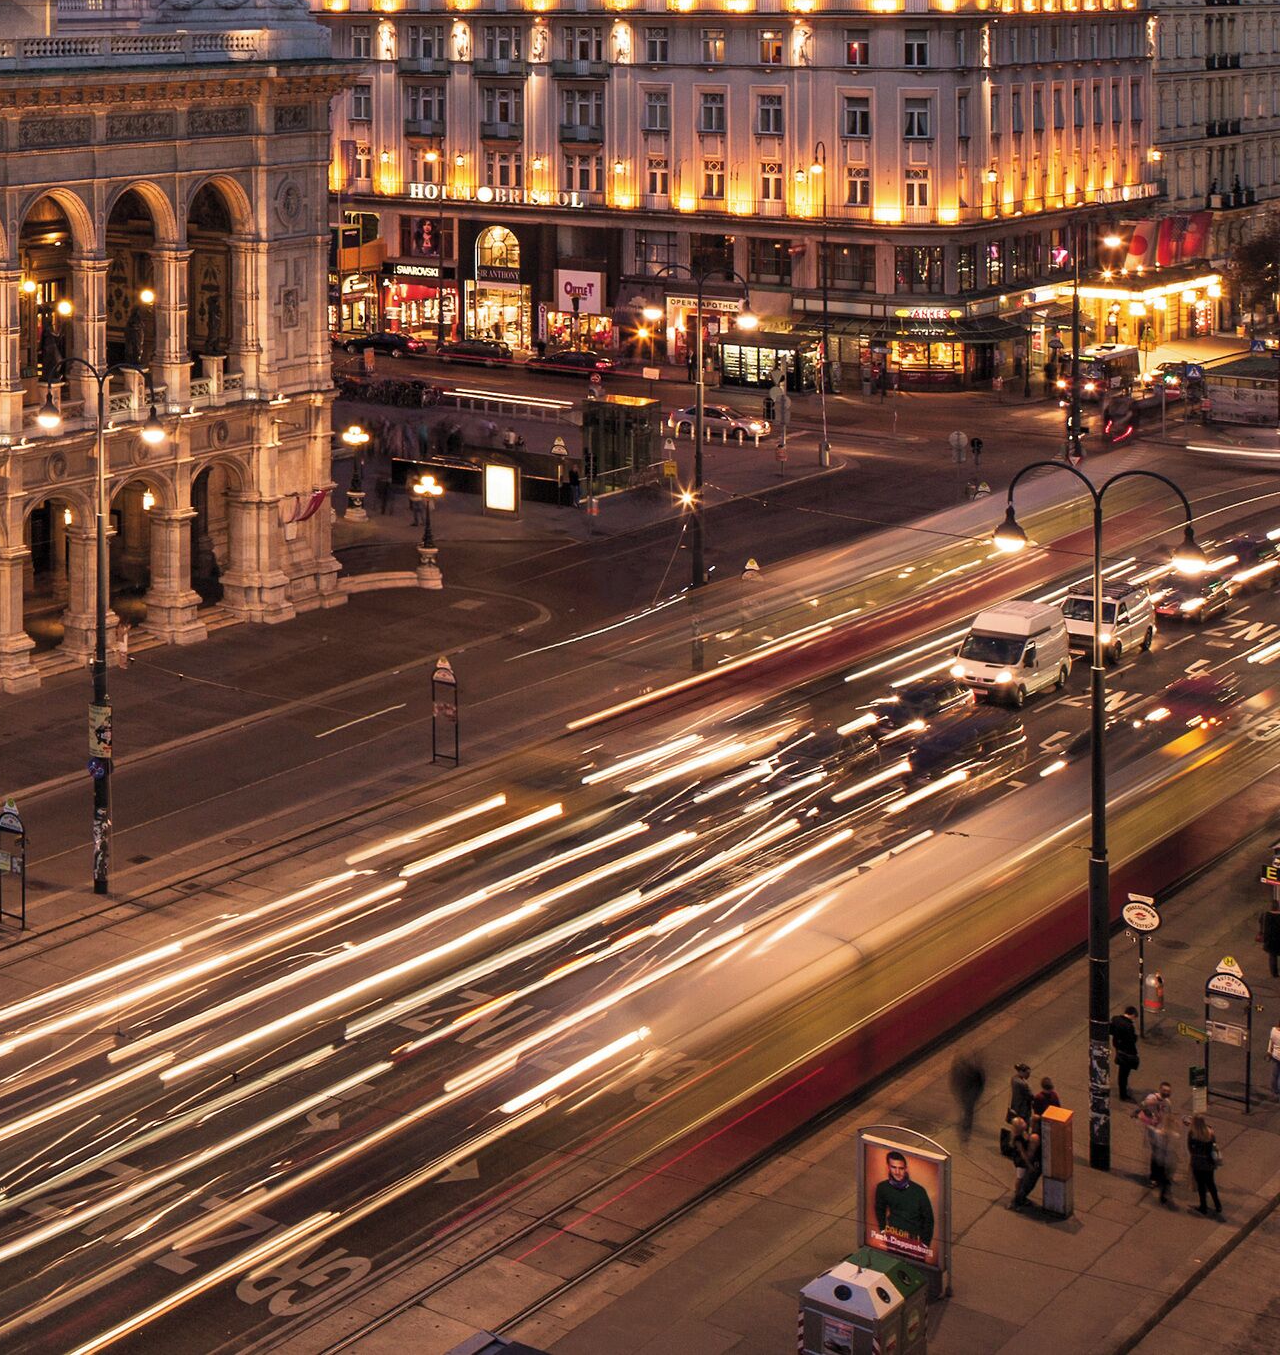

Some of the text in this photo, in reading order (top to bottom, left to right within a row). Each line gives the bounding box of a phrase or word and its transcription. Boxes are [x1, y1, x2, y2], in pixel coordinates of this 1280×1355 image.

[409, 183, 584, 208] HOTEL BRISTOL
[396, 265, 439, 277] SWAROVSKI
[490, 270, 520, 280] ANTHONY
[670, 298, 740, 310] OPERN APOTHEK
[912, 309, 950, 319] ANKER
[1266, 866, 1278, 880] E
